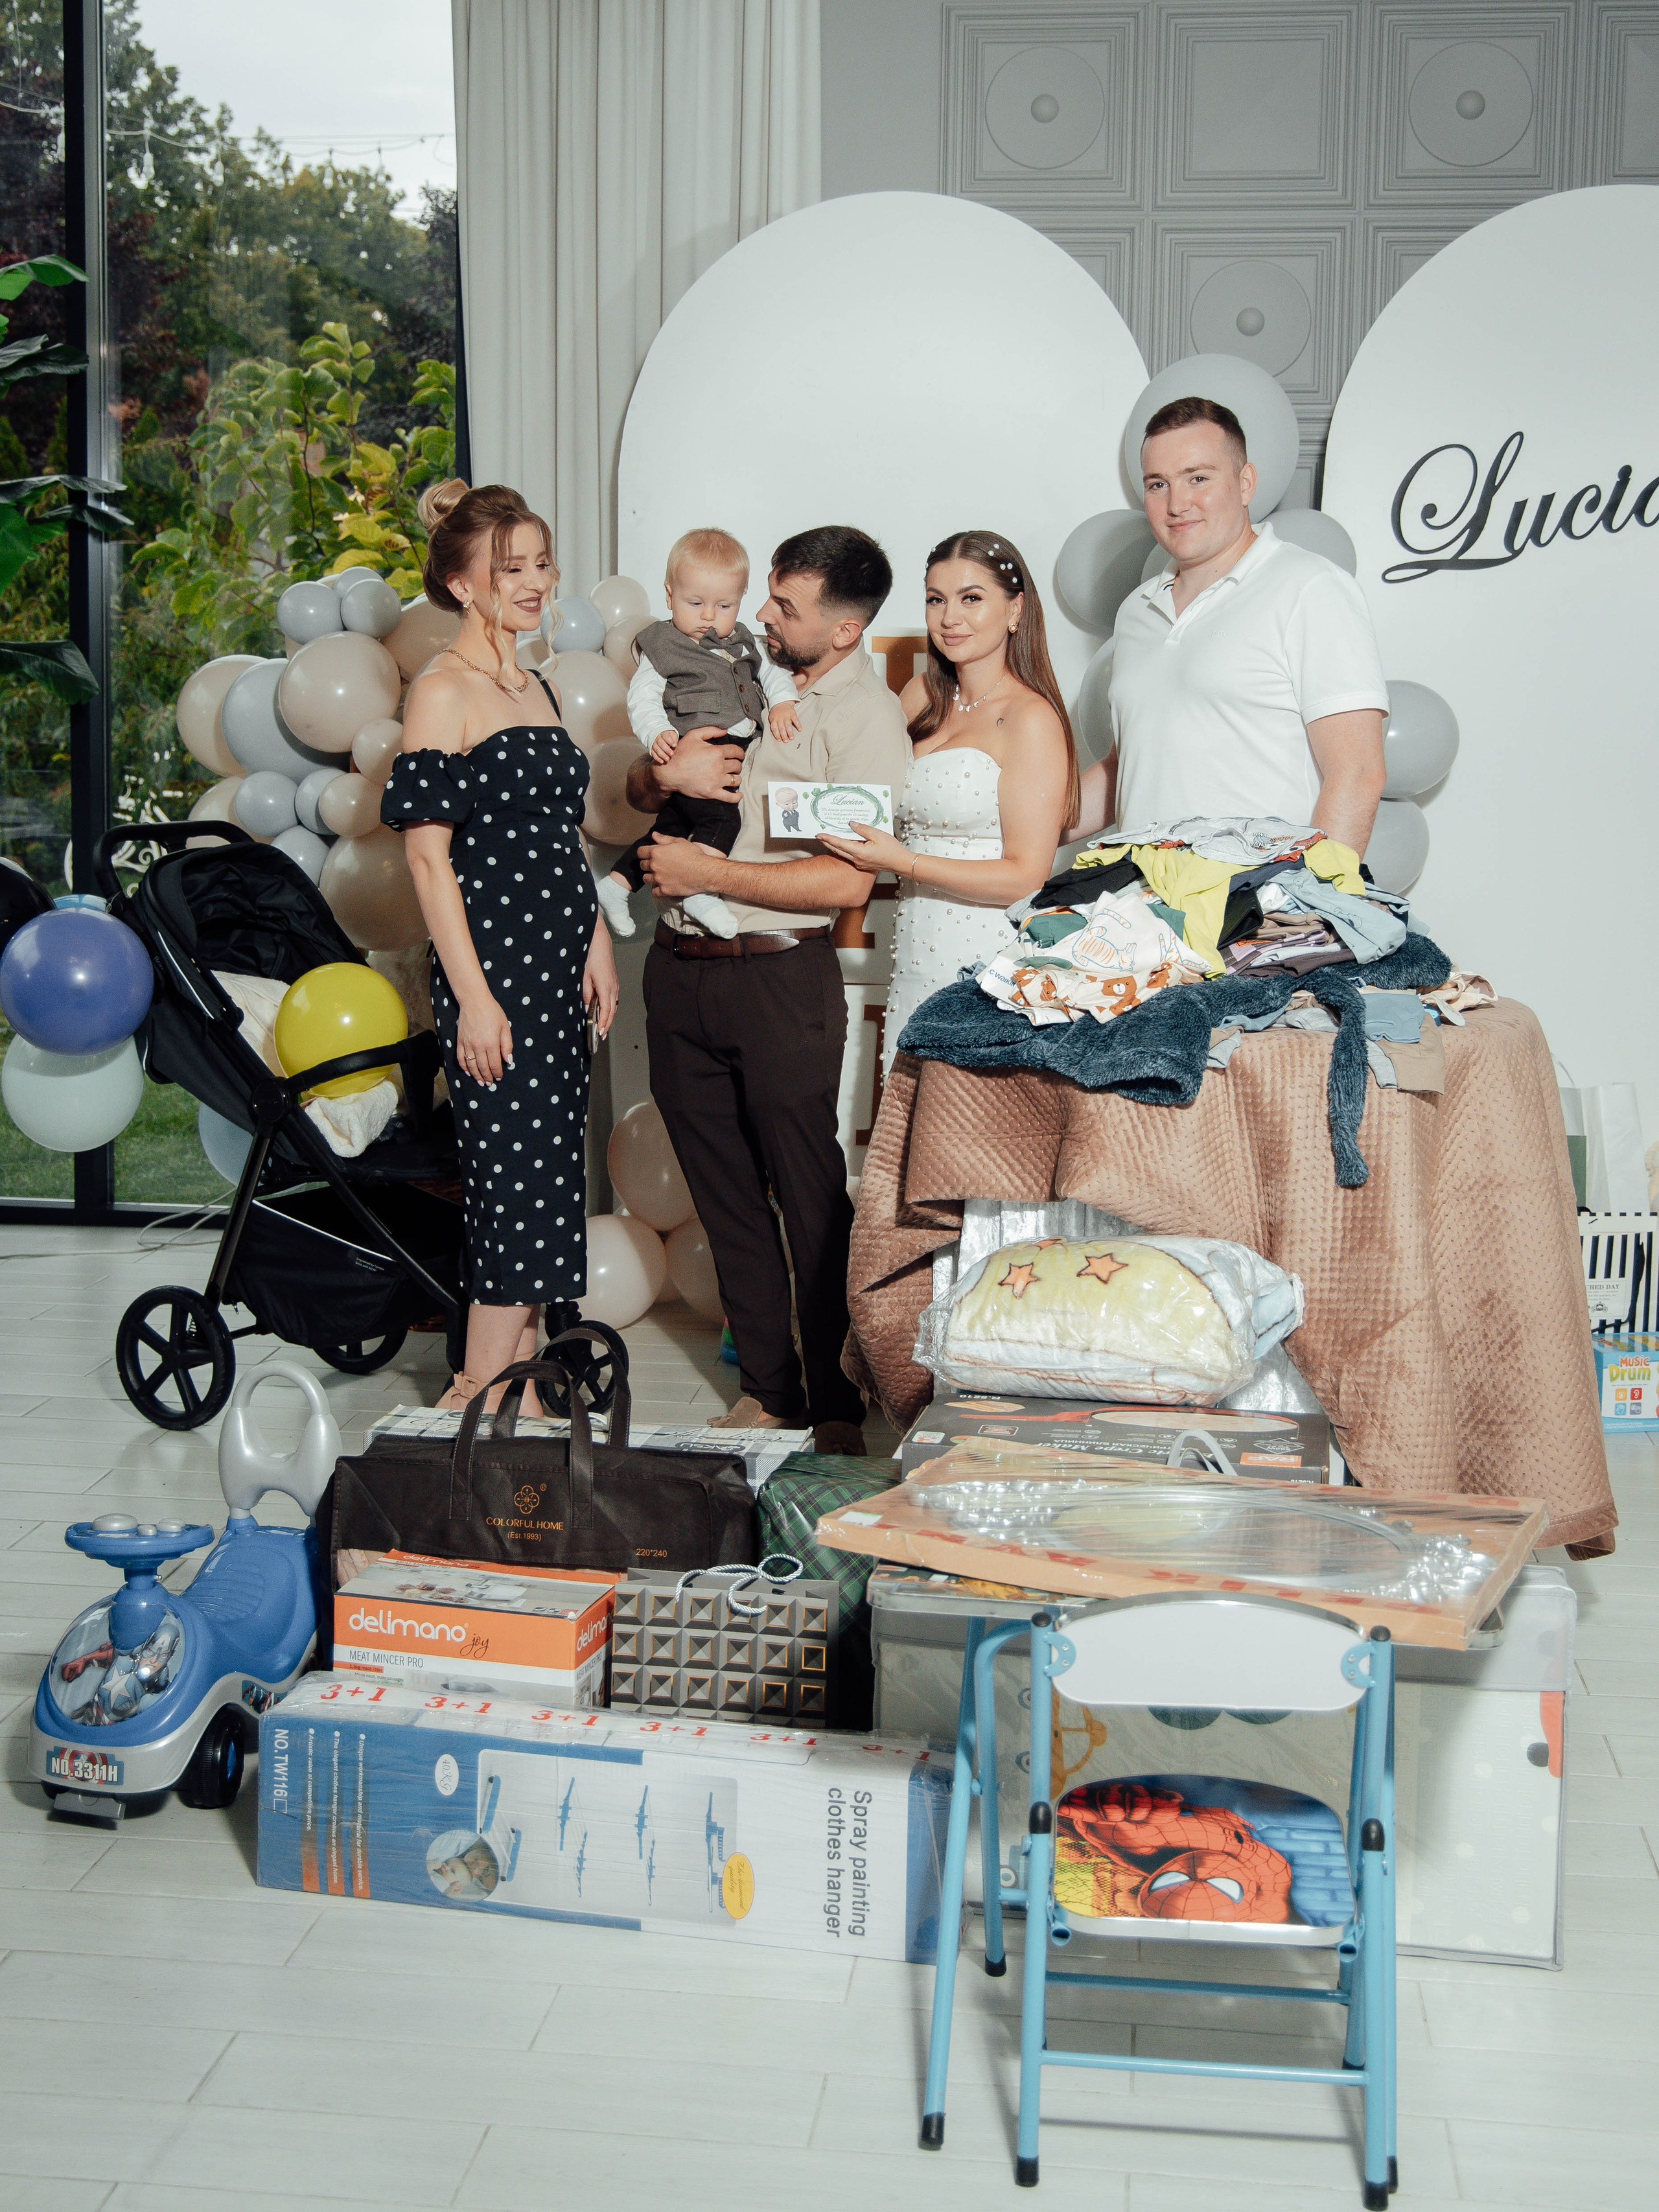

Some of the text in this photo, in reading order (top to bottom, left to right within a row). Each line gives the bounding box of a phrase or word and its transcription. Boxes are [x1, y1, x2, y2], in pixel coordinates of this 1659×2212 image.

[830, 795, 864, 806] Lucian
[1608, 1365, 1651, 1382] Drum
[1033, 1442, 1092, 1452] Maker
[1095, 1445, 1143, 1454] Crepe
[486, 1517, 564, 1530] COLORFUL HOME
[403, 1555, 469, 1566] delimano
[349, 1607, 489, 1659] delimano joy
[349, 1649, 424, 1668] MEAT MINCER PRO
[320, 1684, 387, 1702] 3+1
[424, 1696, 493, 1714] 3+1
[531, 1710, 600, 1727] 3+1
[640, 1721, 709, 1736] 3+1
[750, 1732, 818, 1746] 3+1
[862, 1744, 931, 1762] 3+1
[51, 1757, 119, 1782] NO.3311H
[273, 1729, 288, 1797] NO.TW116
[824, 1787, 846, 1938] clothes hanger
[848, 1790, 872, 1937] Spray painting
[727, 1866, 737, 1893] quality
